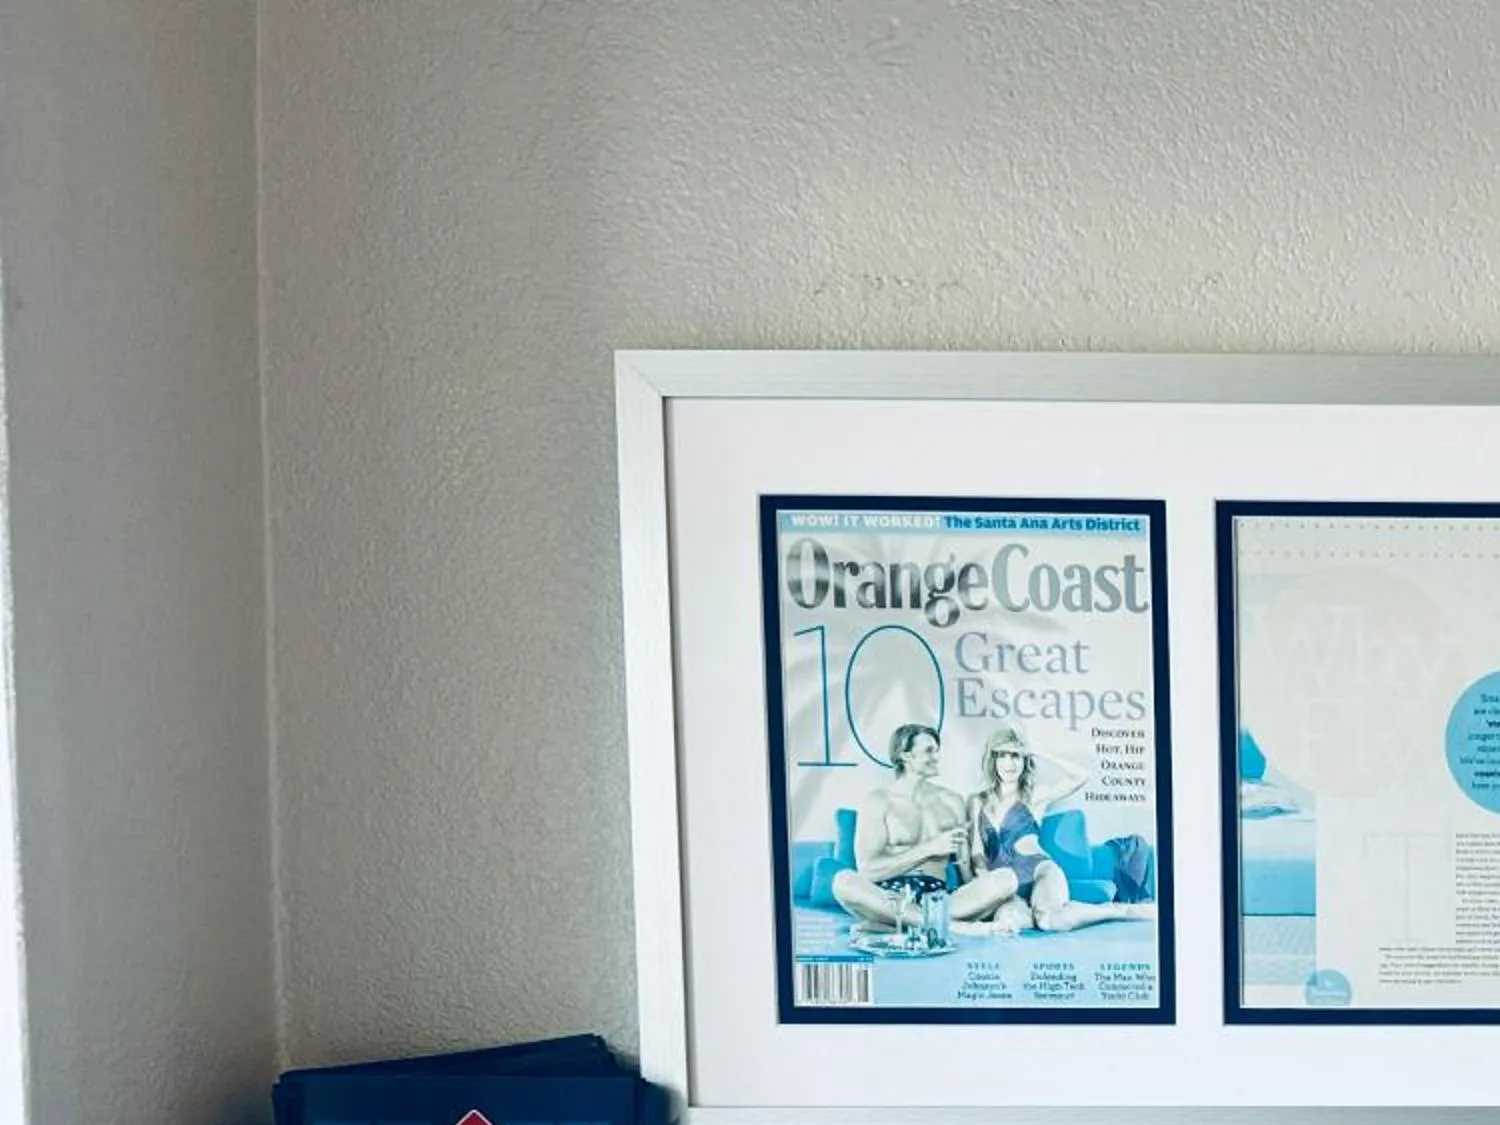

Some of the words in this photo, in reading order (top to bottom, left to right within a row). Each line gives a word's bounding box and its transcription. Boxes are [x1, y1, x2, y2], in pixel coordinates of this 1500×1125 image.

[791, 515, 839, 527] WOW!
[844, 516, 860, 527] IT
[943, 517, 972, 529] The
[975, 517, 1017, 530] Santa
[1020, 518, 1048, 530] Ana
[1051, 518, 1082, 531] Arts
[1085, 518, 1141, 531] District
[954, 631, 1090, 674] Great
[794, 625, 945, 769] 10
[955, 678, 1147, 732] Escapes
